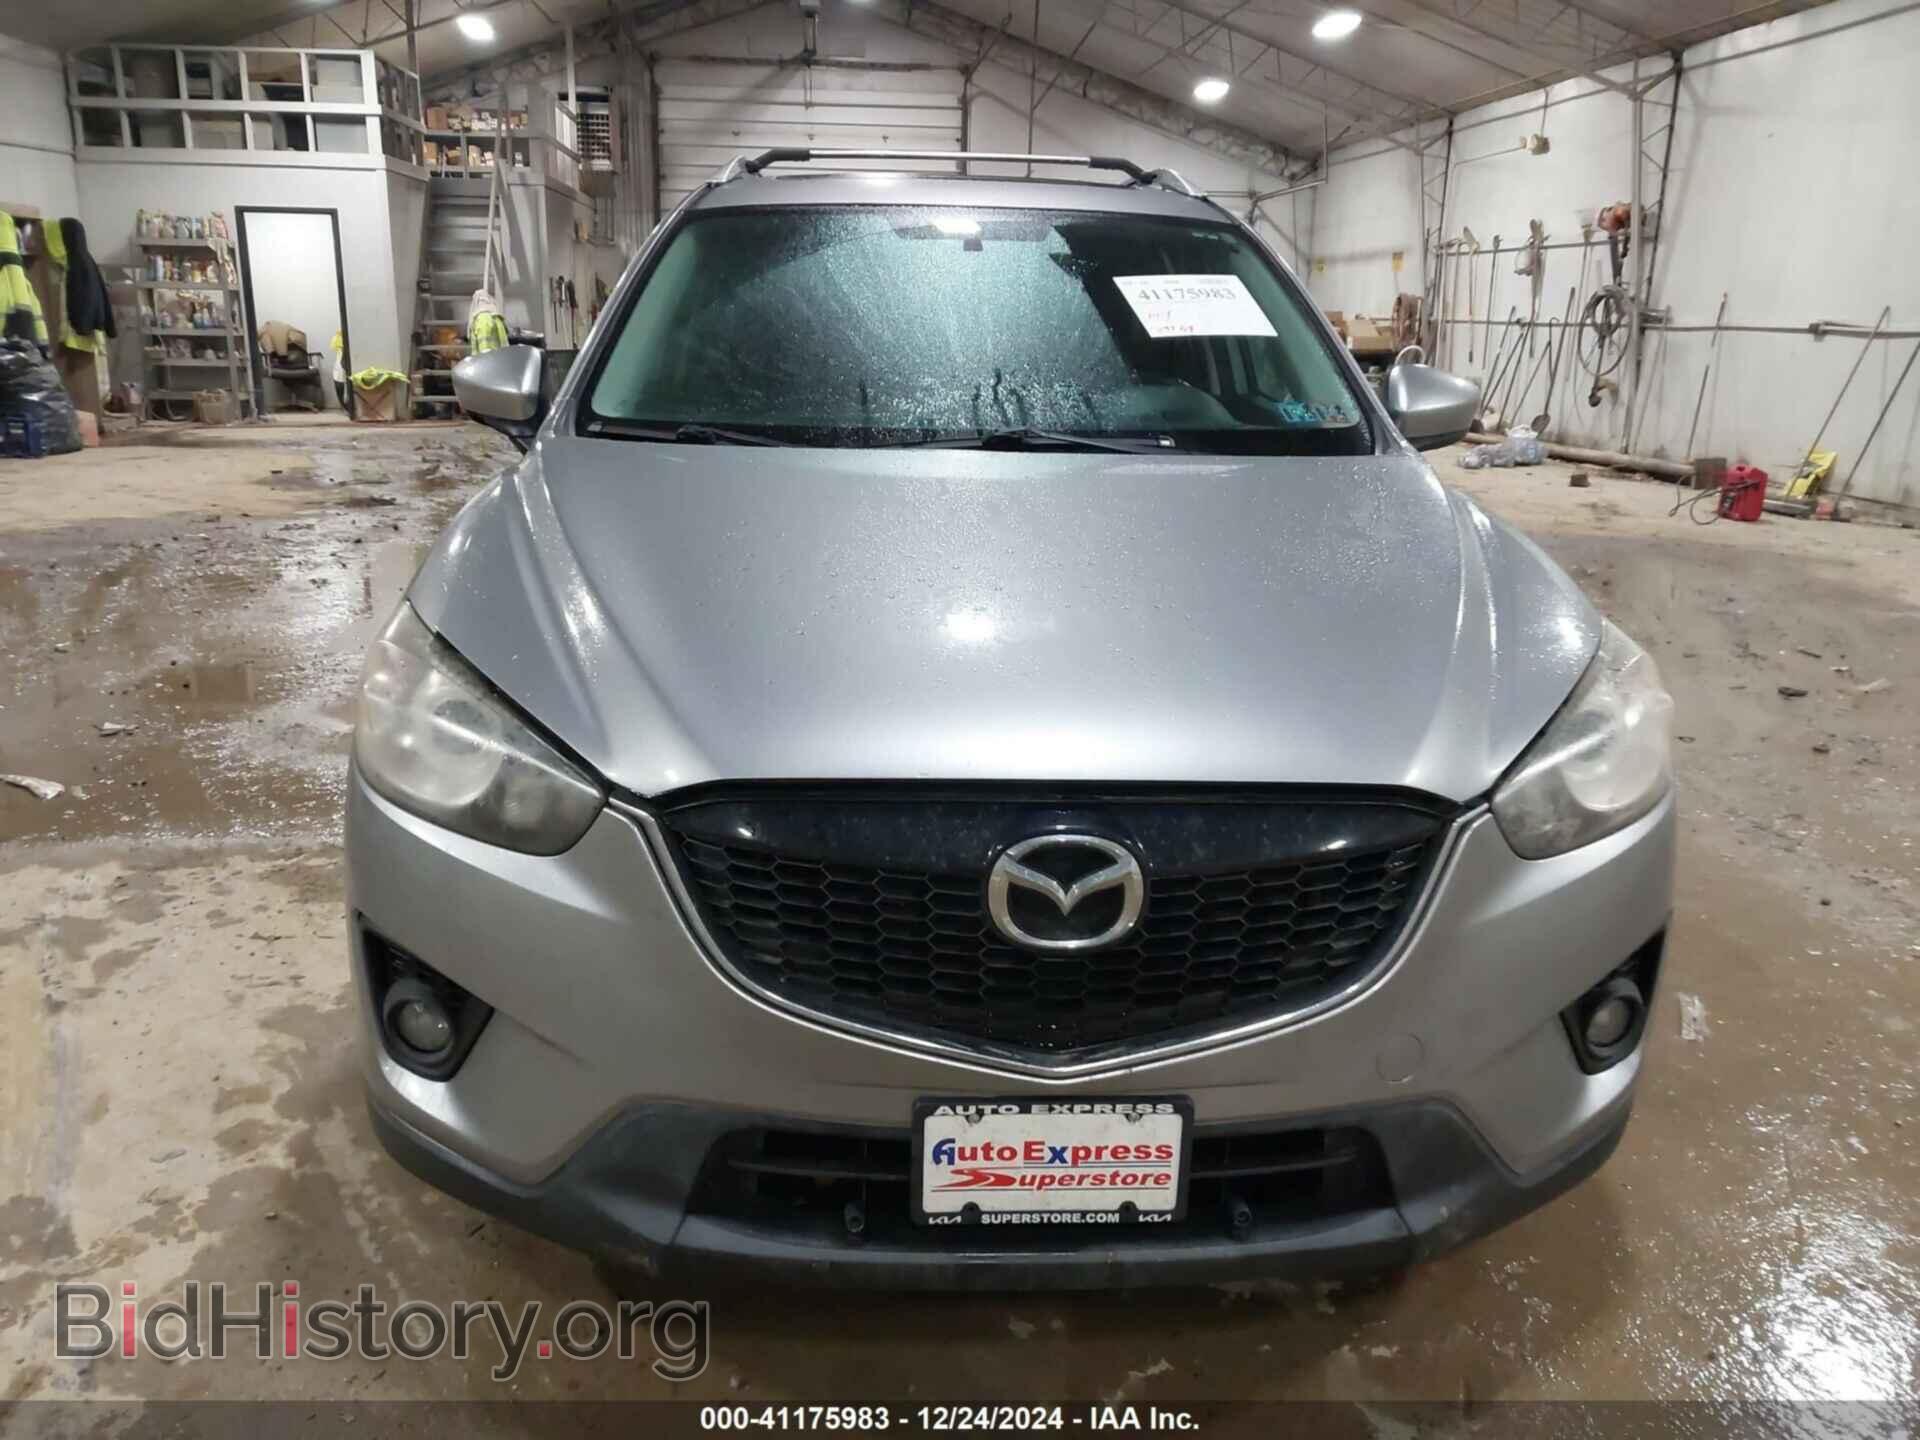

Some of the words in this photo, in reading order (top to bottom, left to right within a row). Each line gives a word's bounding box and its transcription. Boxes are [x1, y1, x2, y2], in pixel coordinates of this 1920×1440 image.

[1138, 287, 1237, 300] 41175983
[934, 1104, 1020, 1116] AUTO
[1030, 1103, 1175, 1115] EXPRESS
[981, 1212, 1120, 1224] SUPERSTORE.COM
